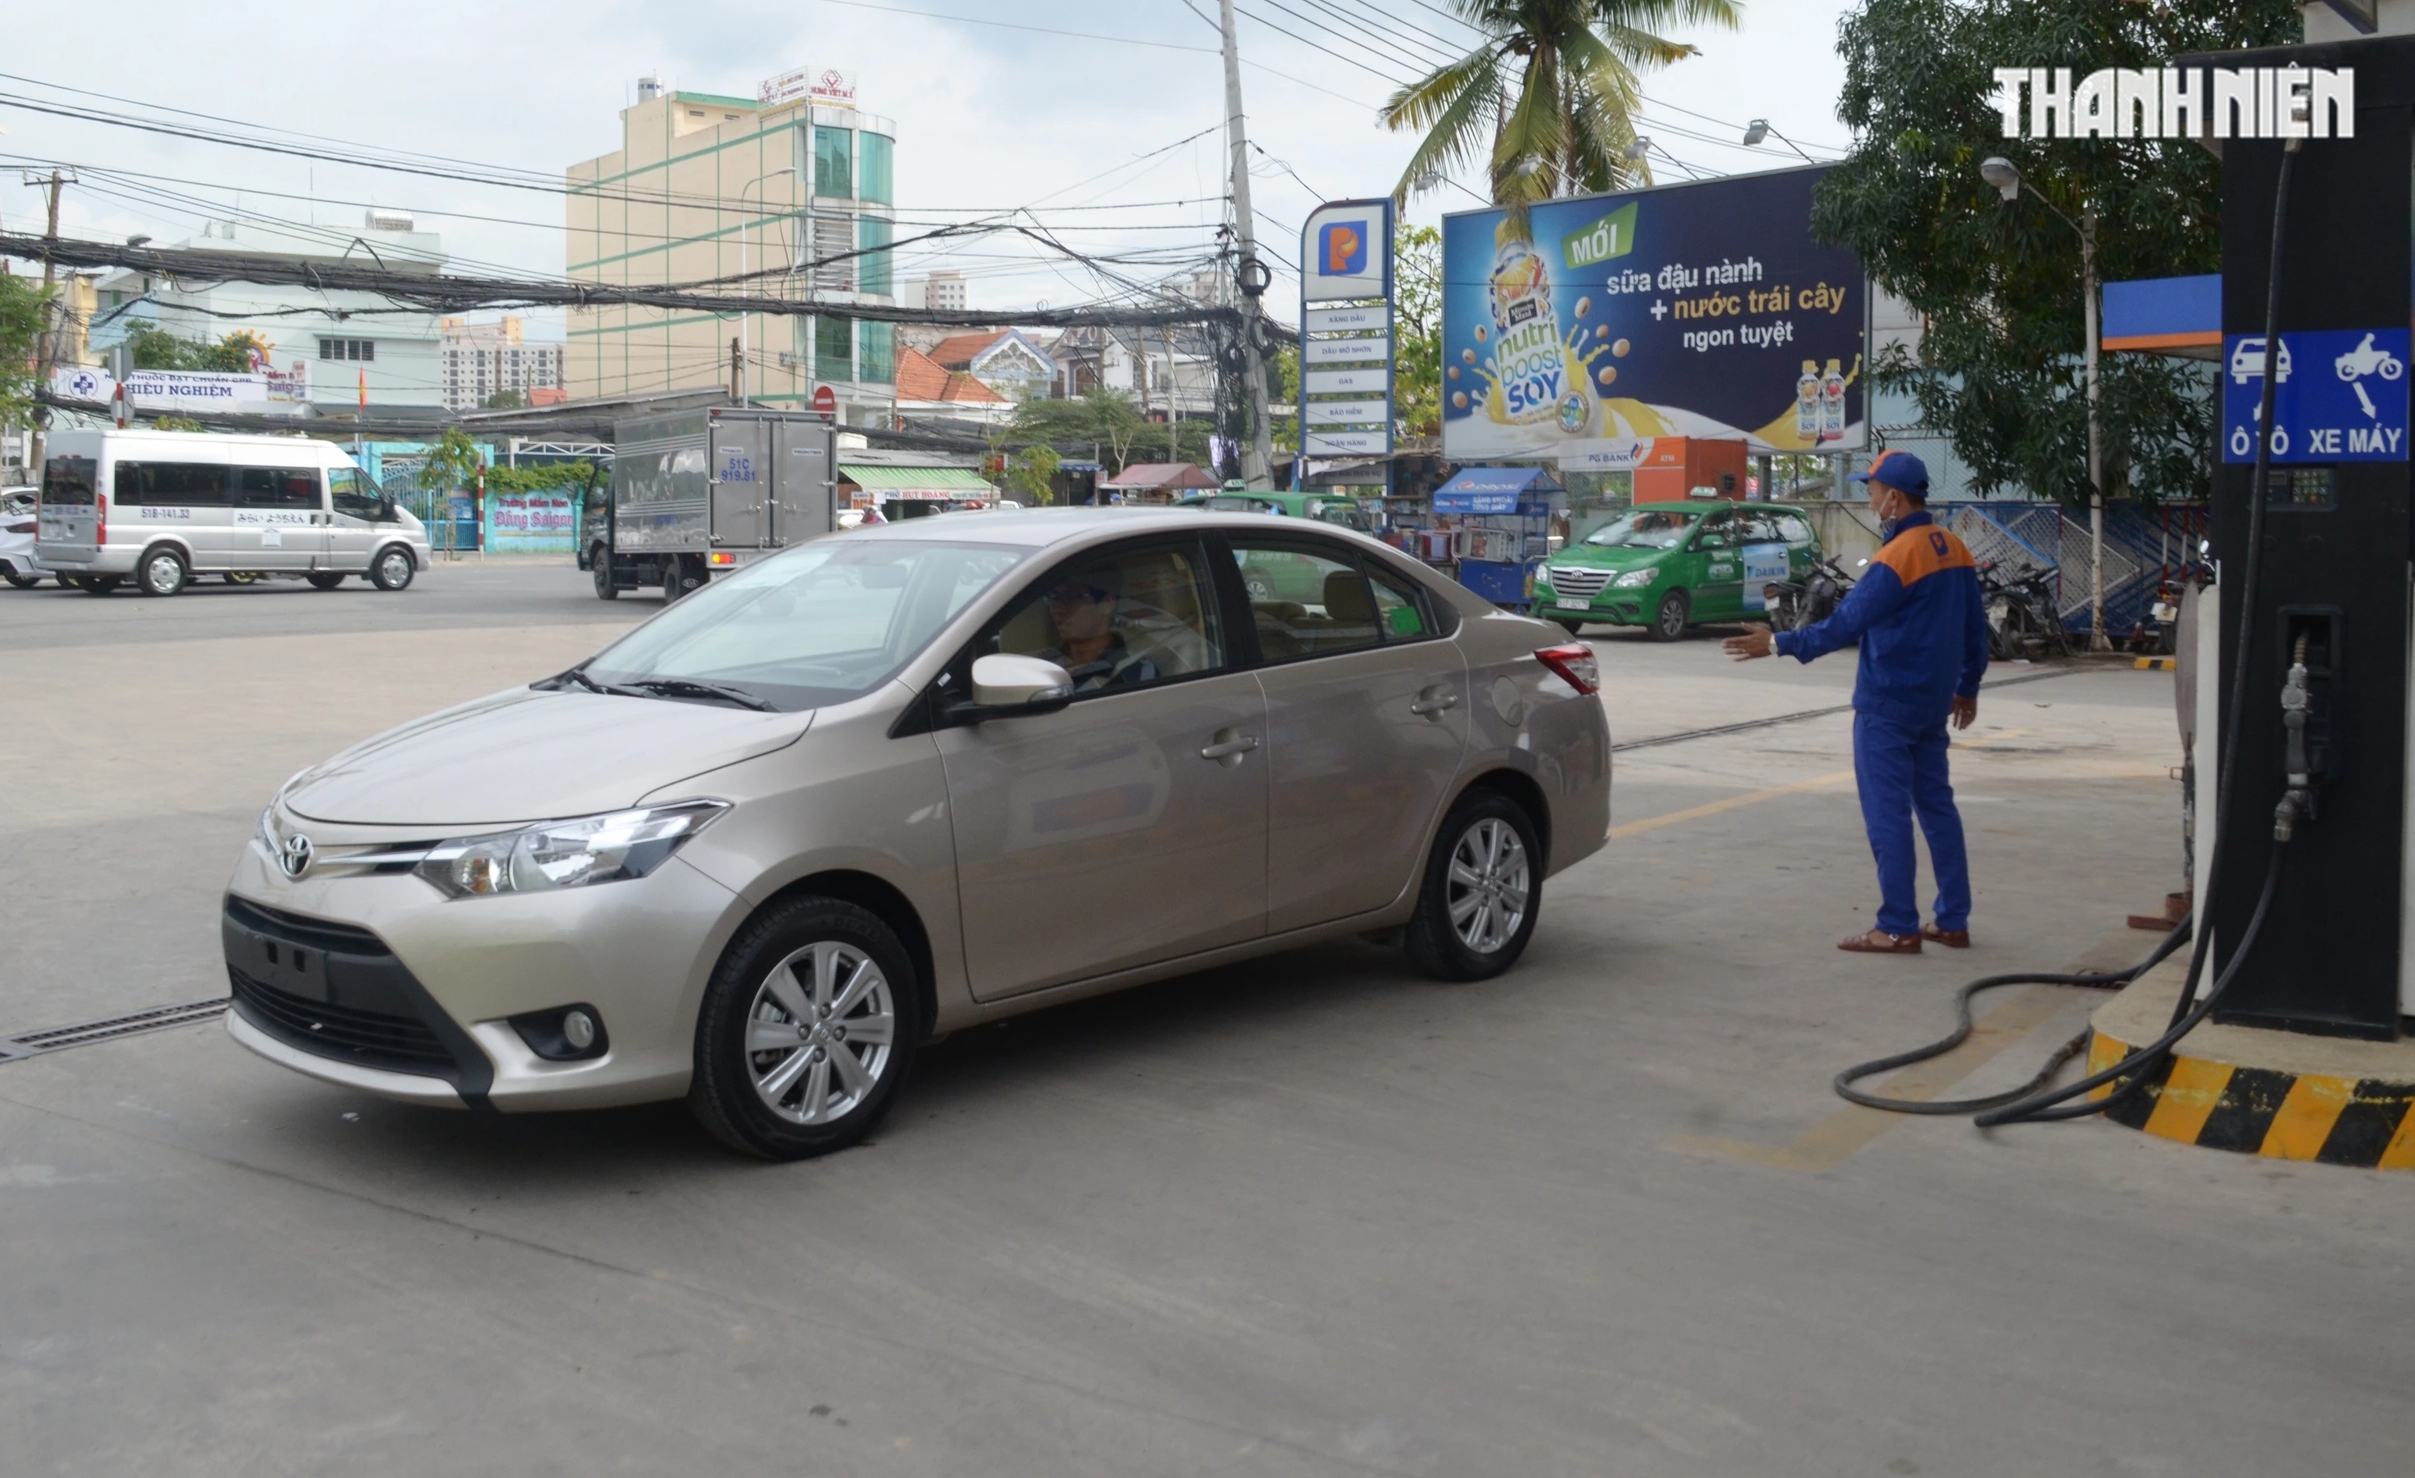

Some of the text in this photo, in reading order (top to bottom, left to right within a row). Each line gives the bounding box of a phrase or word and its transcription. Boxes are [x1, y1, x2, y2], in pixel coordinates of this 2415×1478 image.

[1571, 219, 1618, 264] MỚI
[1607, 256, 1762, 295] sữa đậu nành
[1650, 281, 1846, 321] + nước trái cây
[1497, 315, 1558, 364] nutri
[1683, 320, 1793, 352] ngon tuyệt
[1501, 345, 1563, 388] boost
[169, 383, 233, 398] NGHIỆM
[1508, 371, 1561, 413] SOY
[2230, 425, 2250, 456] Ô
[2308, 429, 2342, 454] XE
[2349, 422, 2402, 454] MÁY
[729, 458, 750, 470] 51C
[1602, 453, 1630, 463] BANK
[721, 470, 756, 482] 919.81
[1755, 566, 1787, 578] DAIKIN
